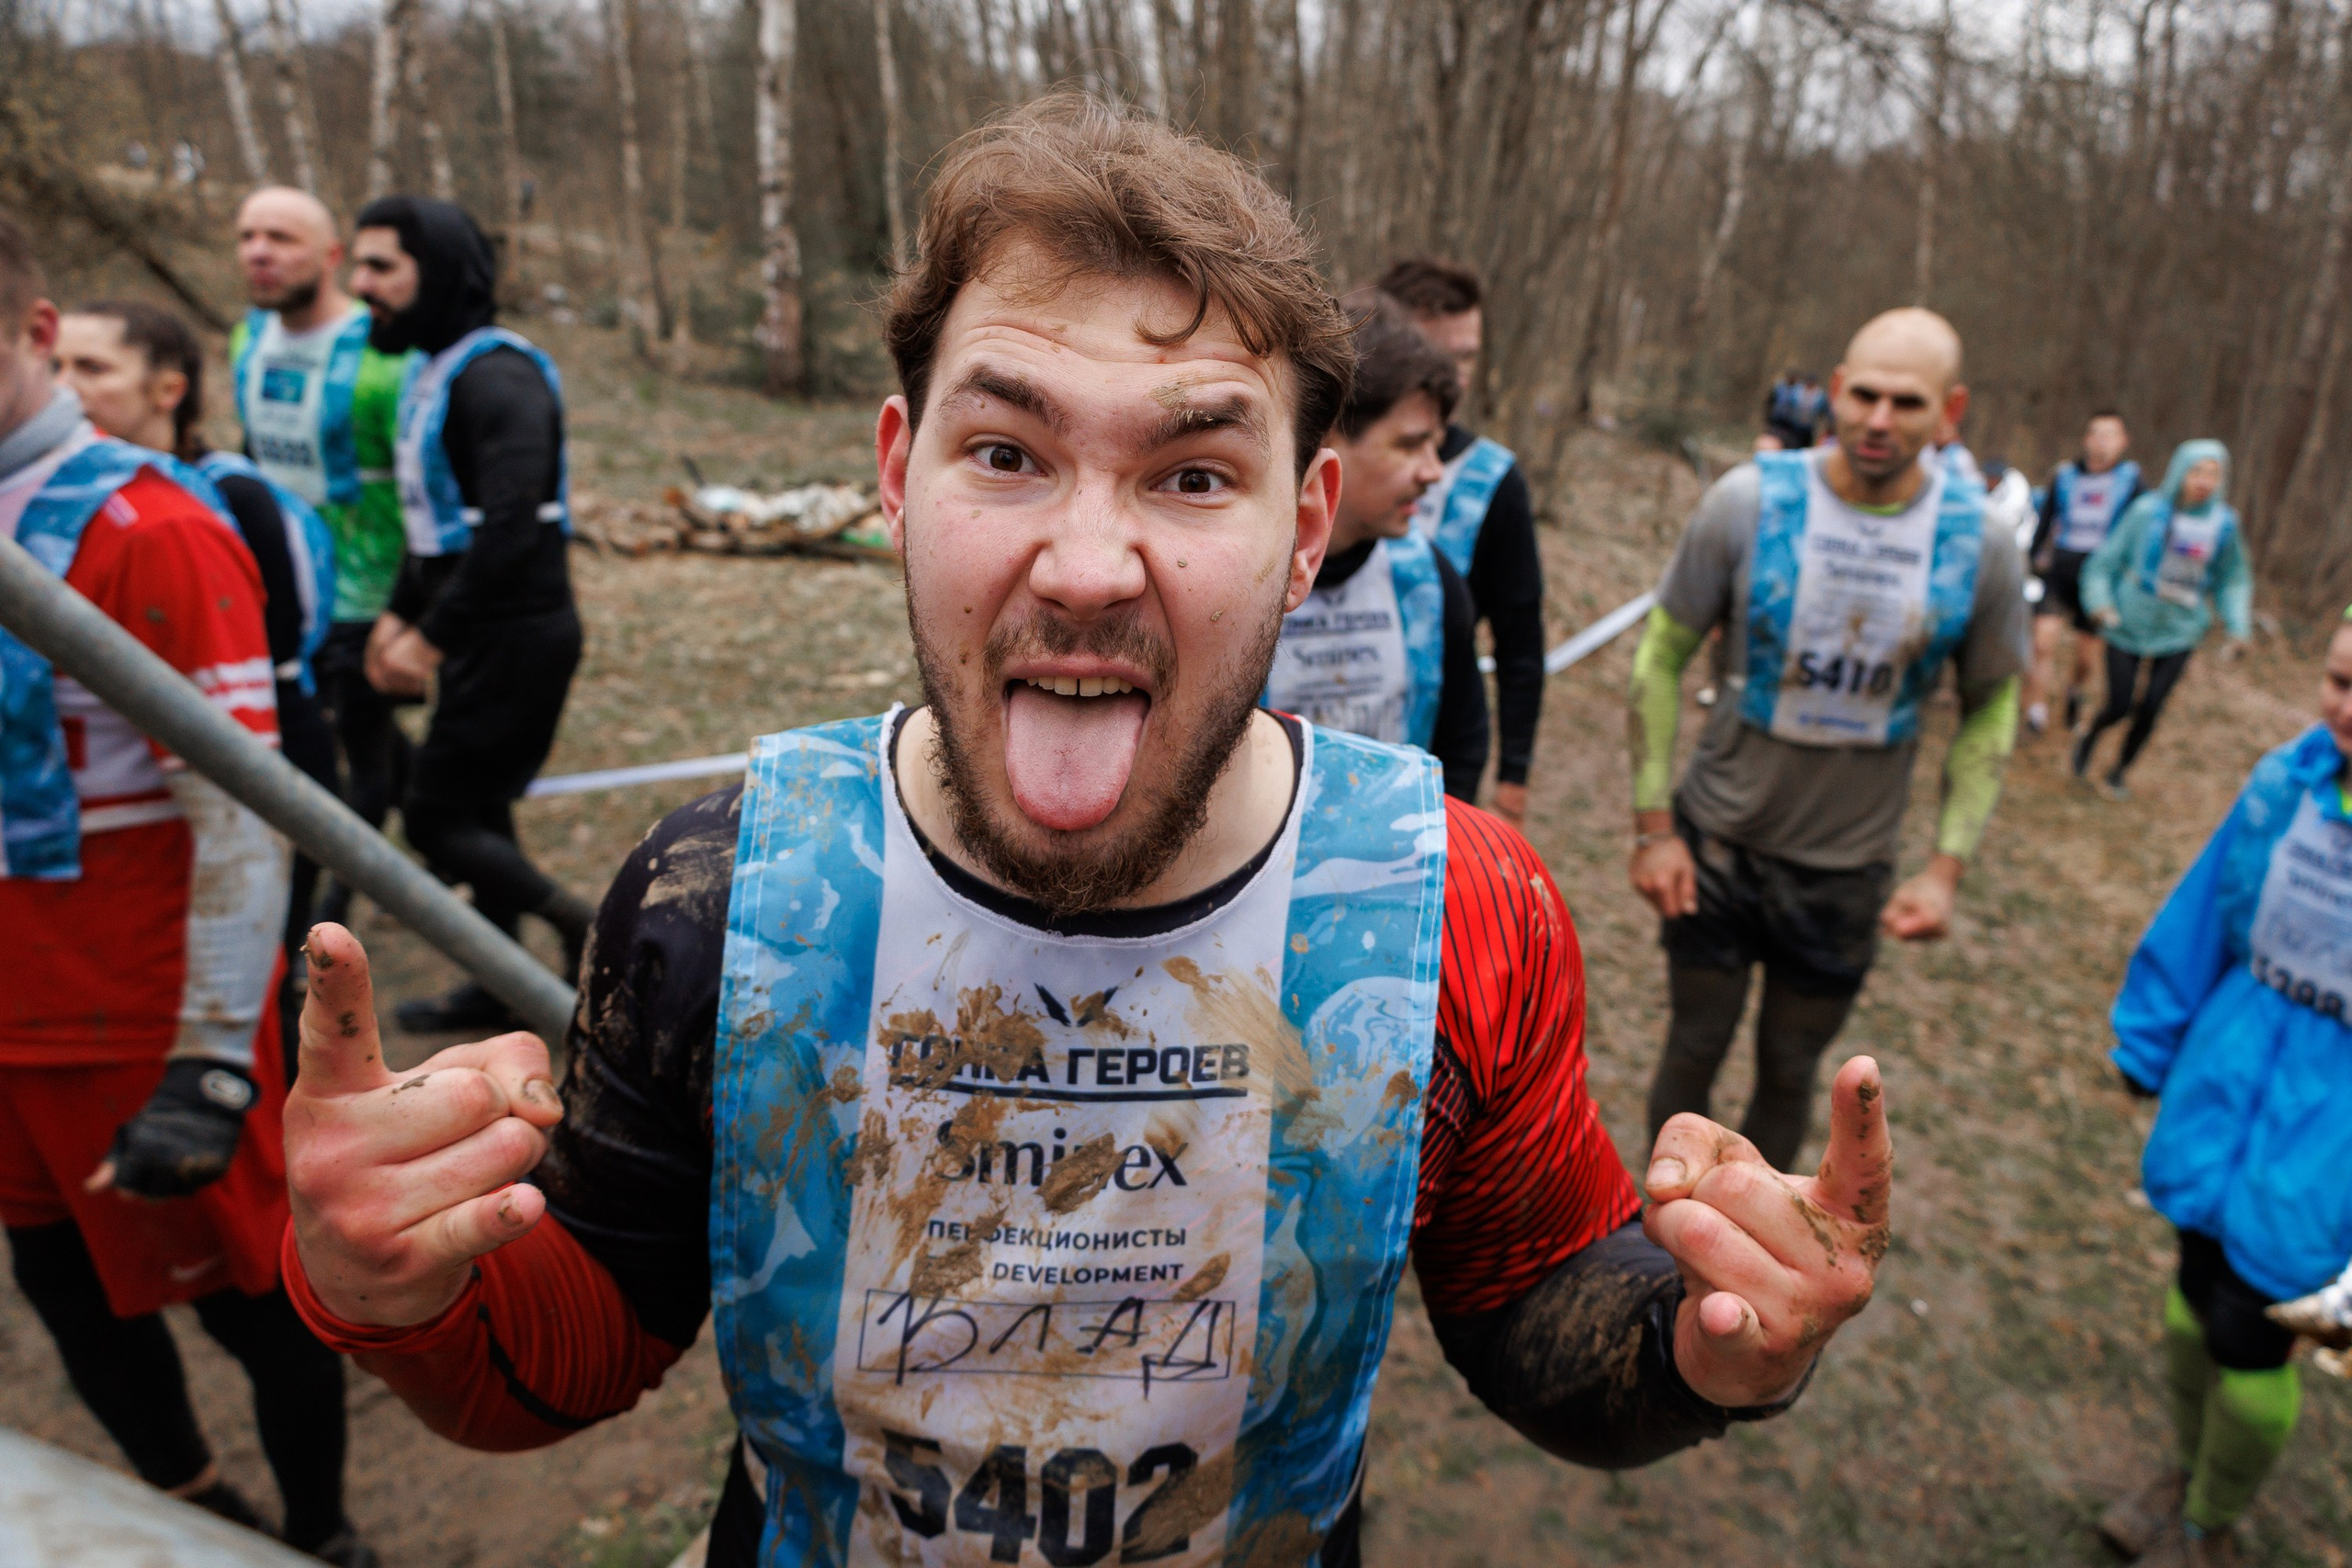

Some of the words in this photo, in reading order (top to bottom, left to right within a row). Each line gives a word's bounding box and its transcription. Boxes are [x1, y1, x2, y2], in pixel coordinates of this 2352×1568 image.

[1067, 1043, 1250, 1085] ГЕРОЕВ
[936, 1119, 1189, 1192] Smiex
[992, 1261, 1185, 1286] DEVELOPMENT
[881, 1427, 1199, 1568] 5402
